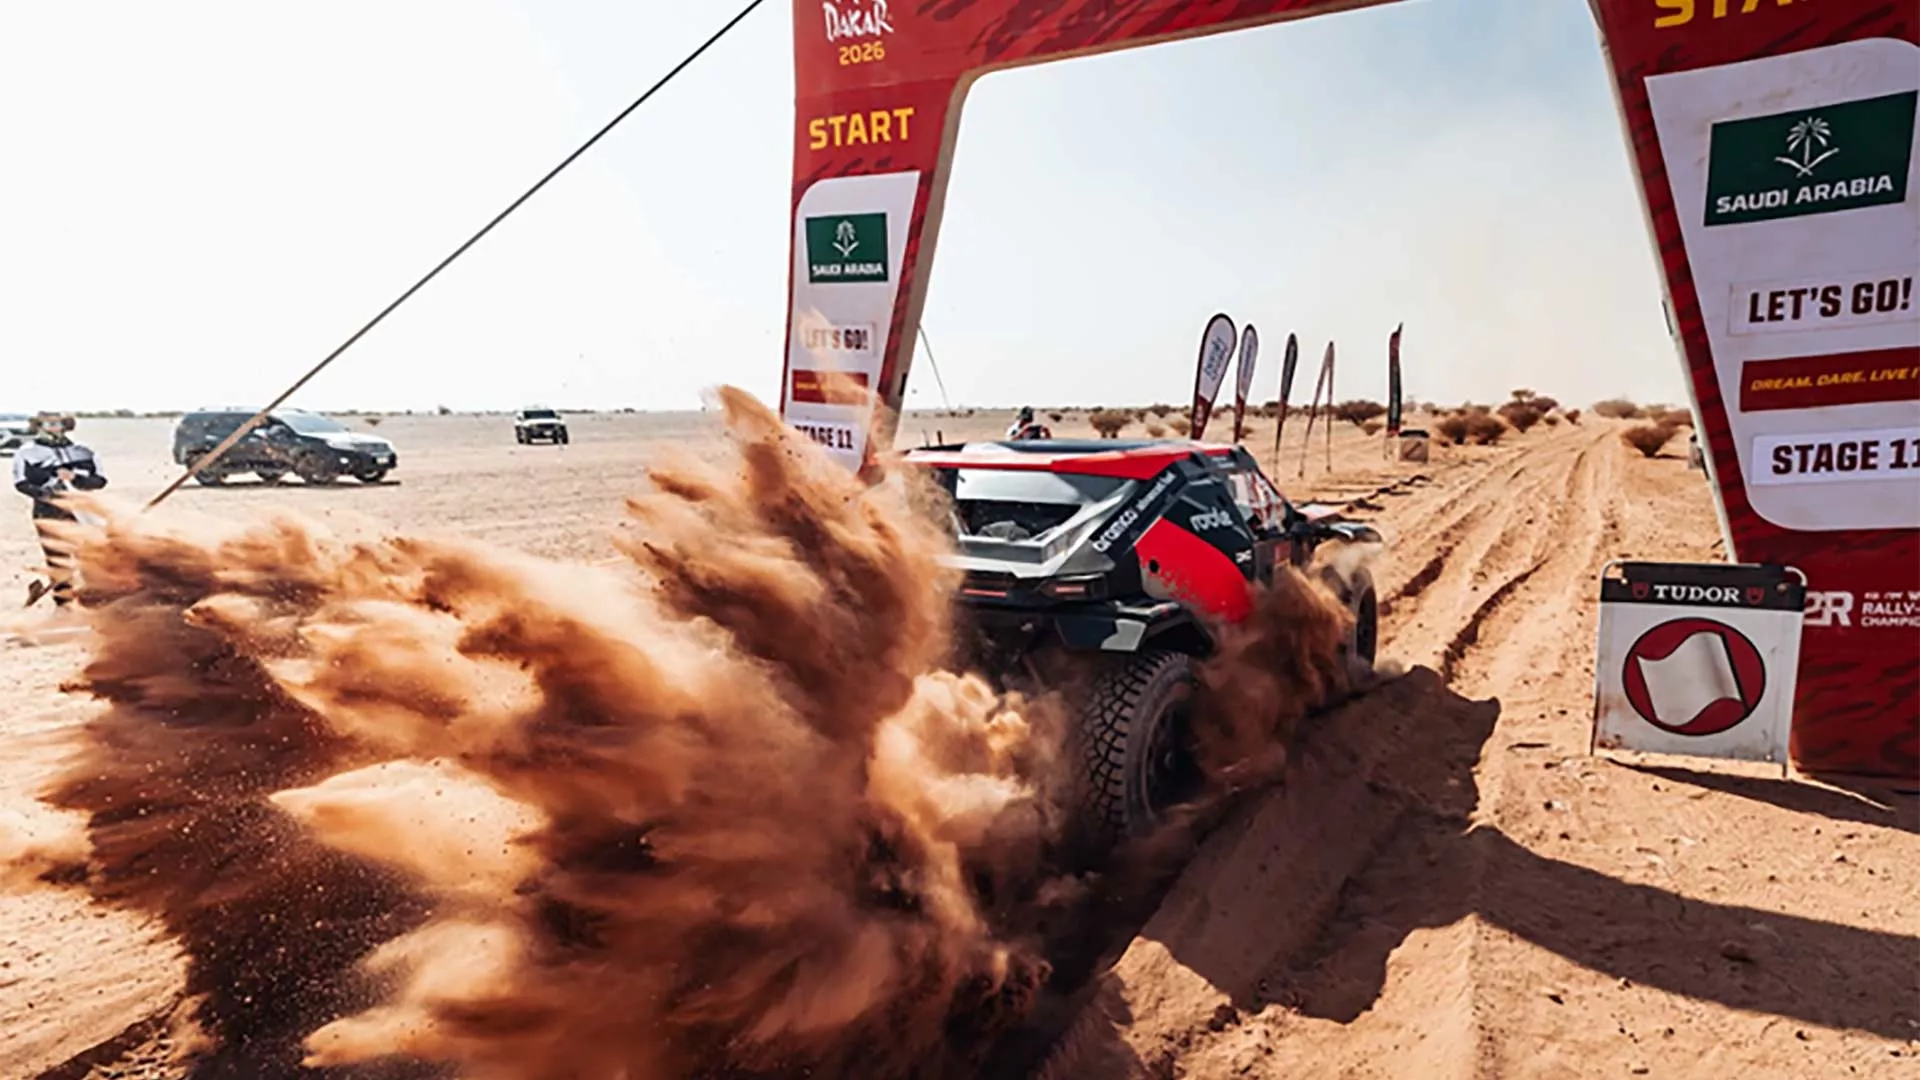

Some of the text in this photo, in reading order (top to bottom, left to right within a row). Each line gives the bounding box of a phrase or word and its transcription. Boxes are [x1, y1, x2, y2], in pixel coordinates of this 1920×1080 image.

[823, 0, 894, 42] DAKAR
[838, 41, 885, 66] 2026
[809, 107, 914, 150] START
[1716, 175, 1893, 214] SAUDI ARABIA
[1749, 276, 1912, 323] LET'S GO!
[844, 328, 868, 350] GO!
[1870, 367, 1909, 382] LIVE
[794, 424, 853, 450] TAGE 11
[1772, 439, 1920, 475] STAGE 11
[1653, 584, 1740, 603] TUDOR
